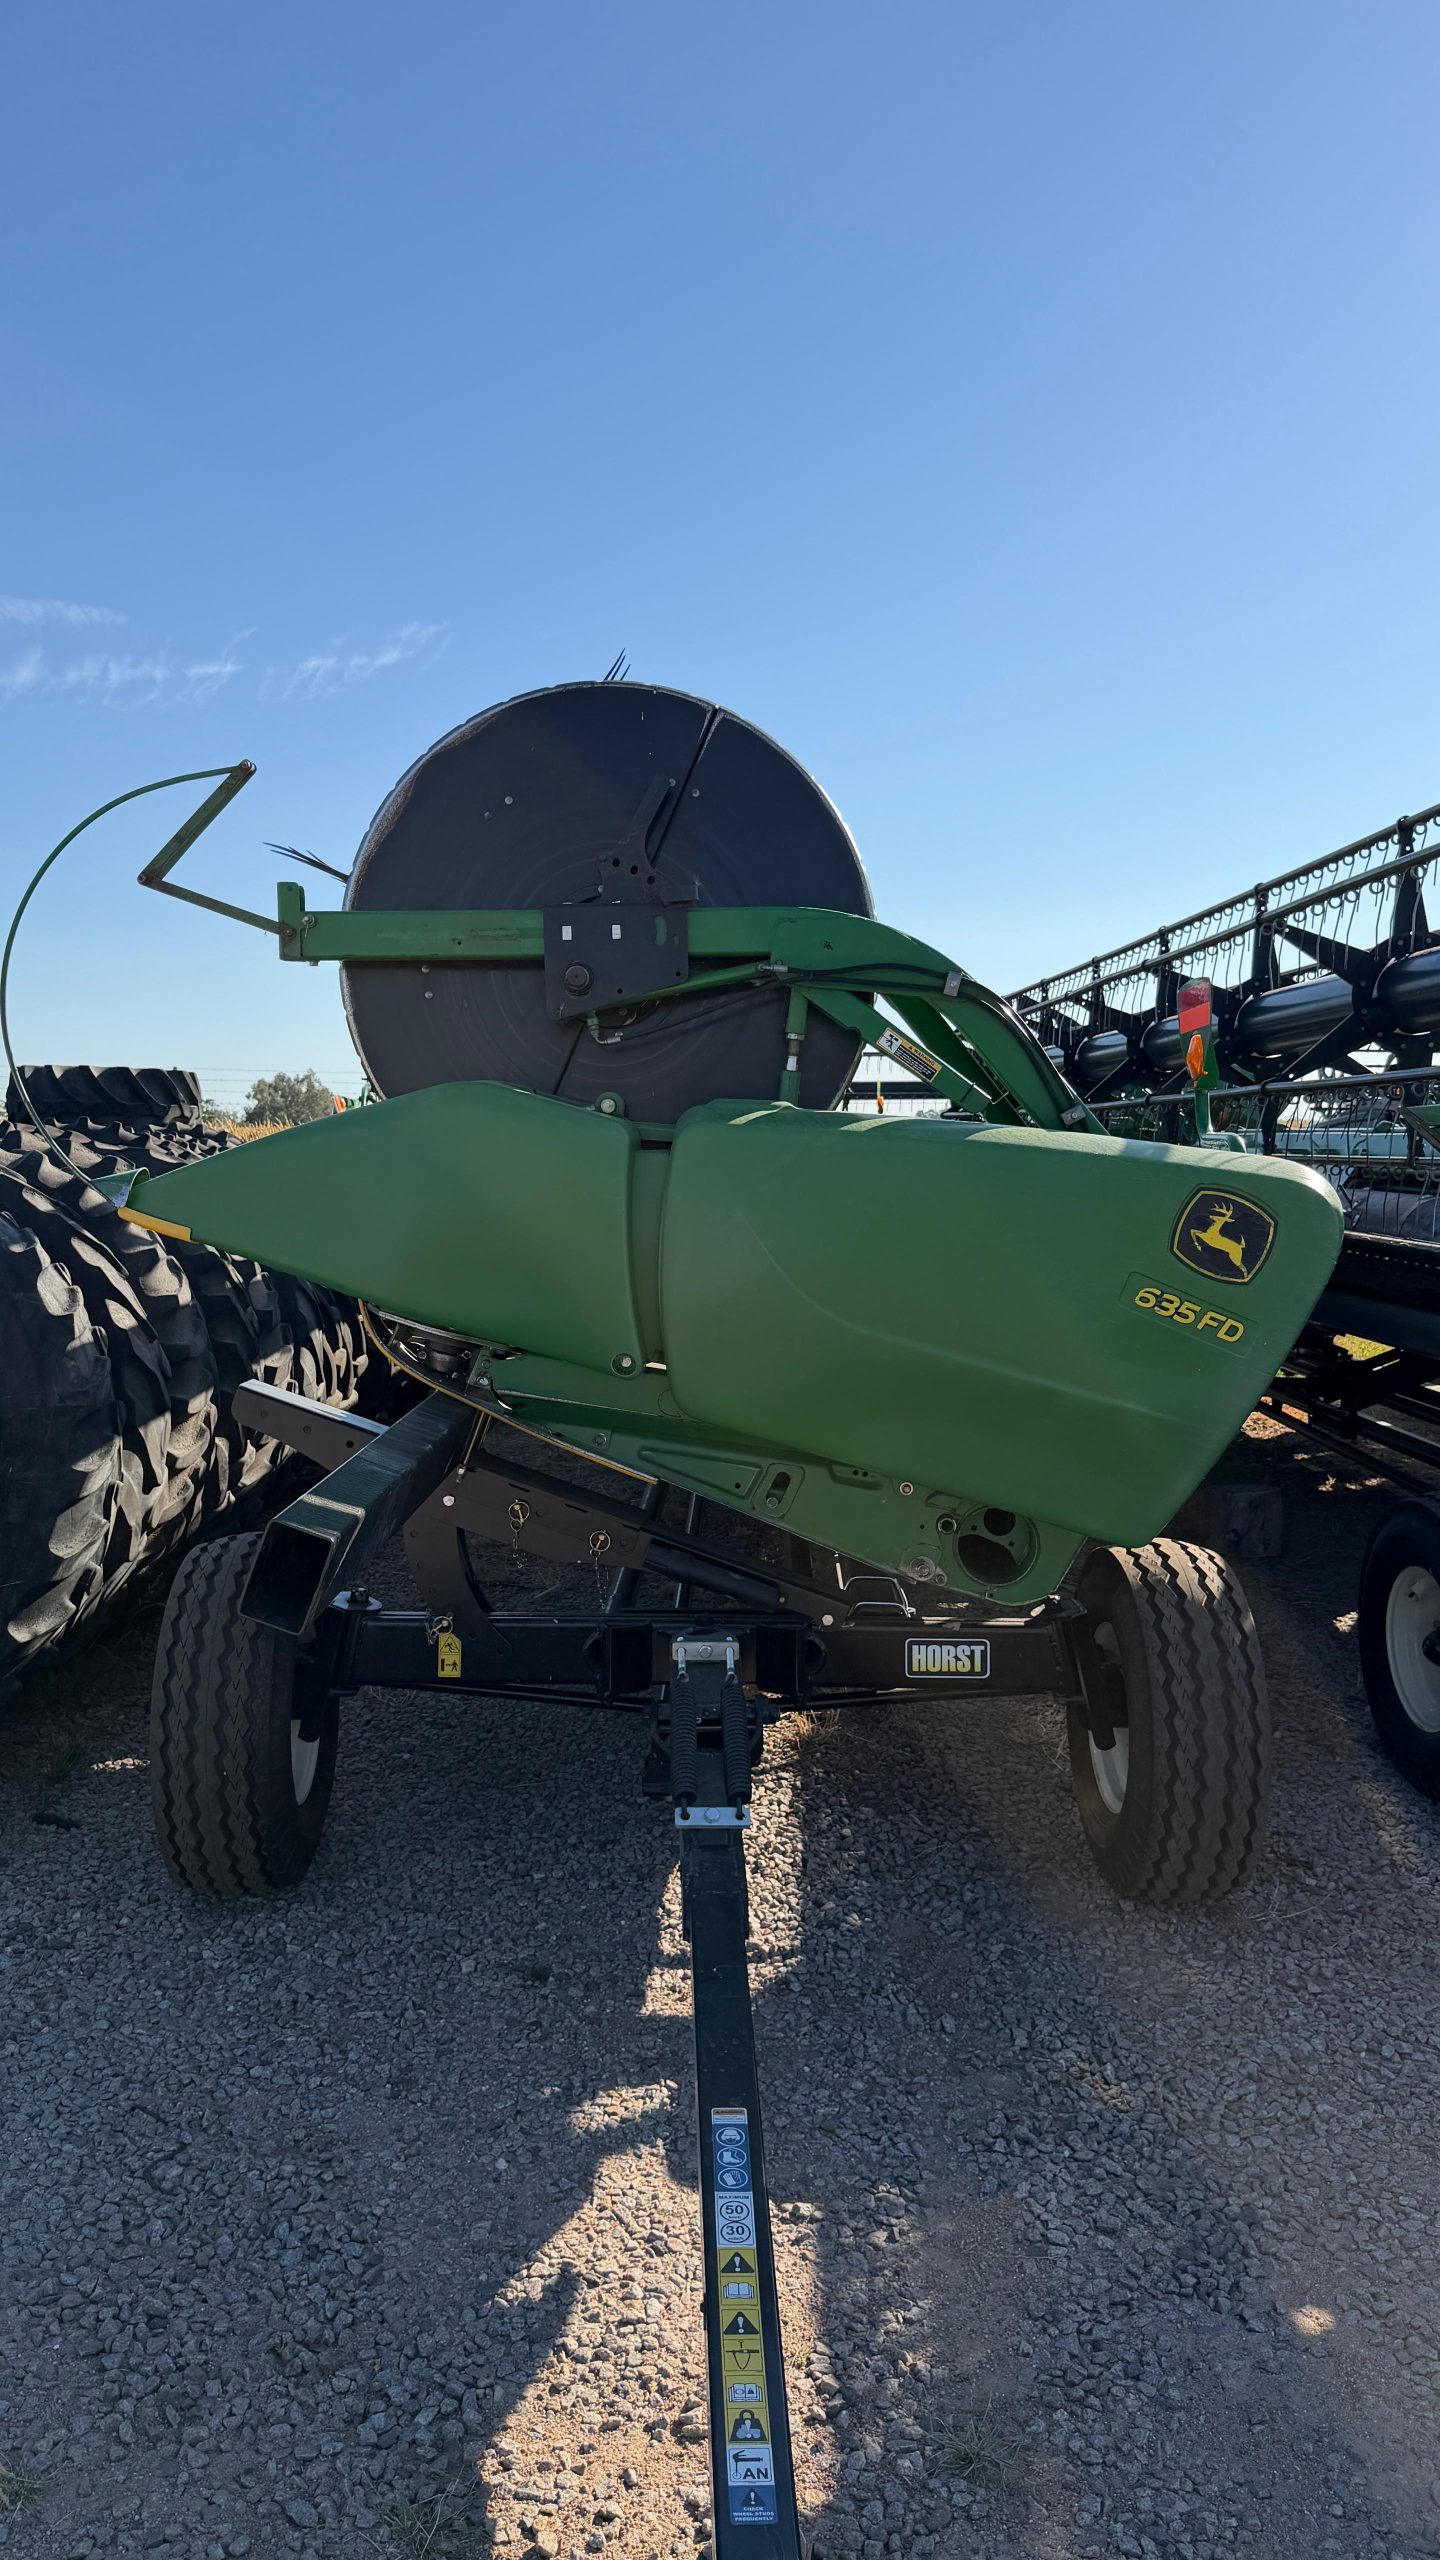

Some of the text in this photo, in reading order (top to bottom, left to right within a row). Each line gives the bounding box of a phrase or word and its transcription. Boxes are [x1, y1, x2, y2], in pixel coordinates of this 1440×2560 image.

[911, 1644, 985, 1673] HORST
[725, 2204, 744, 2215] 50
[726, 2225, 745, 2236] 30
[742, 2467, 769, 2480] AN
